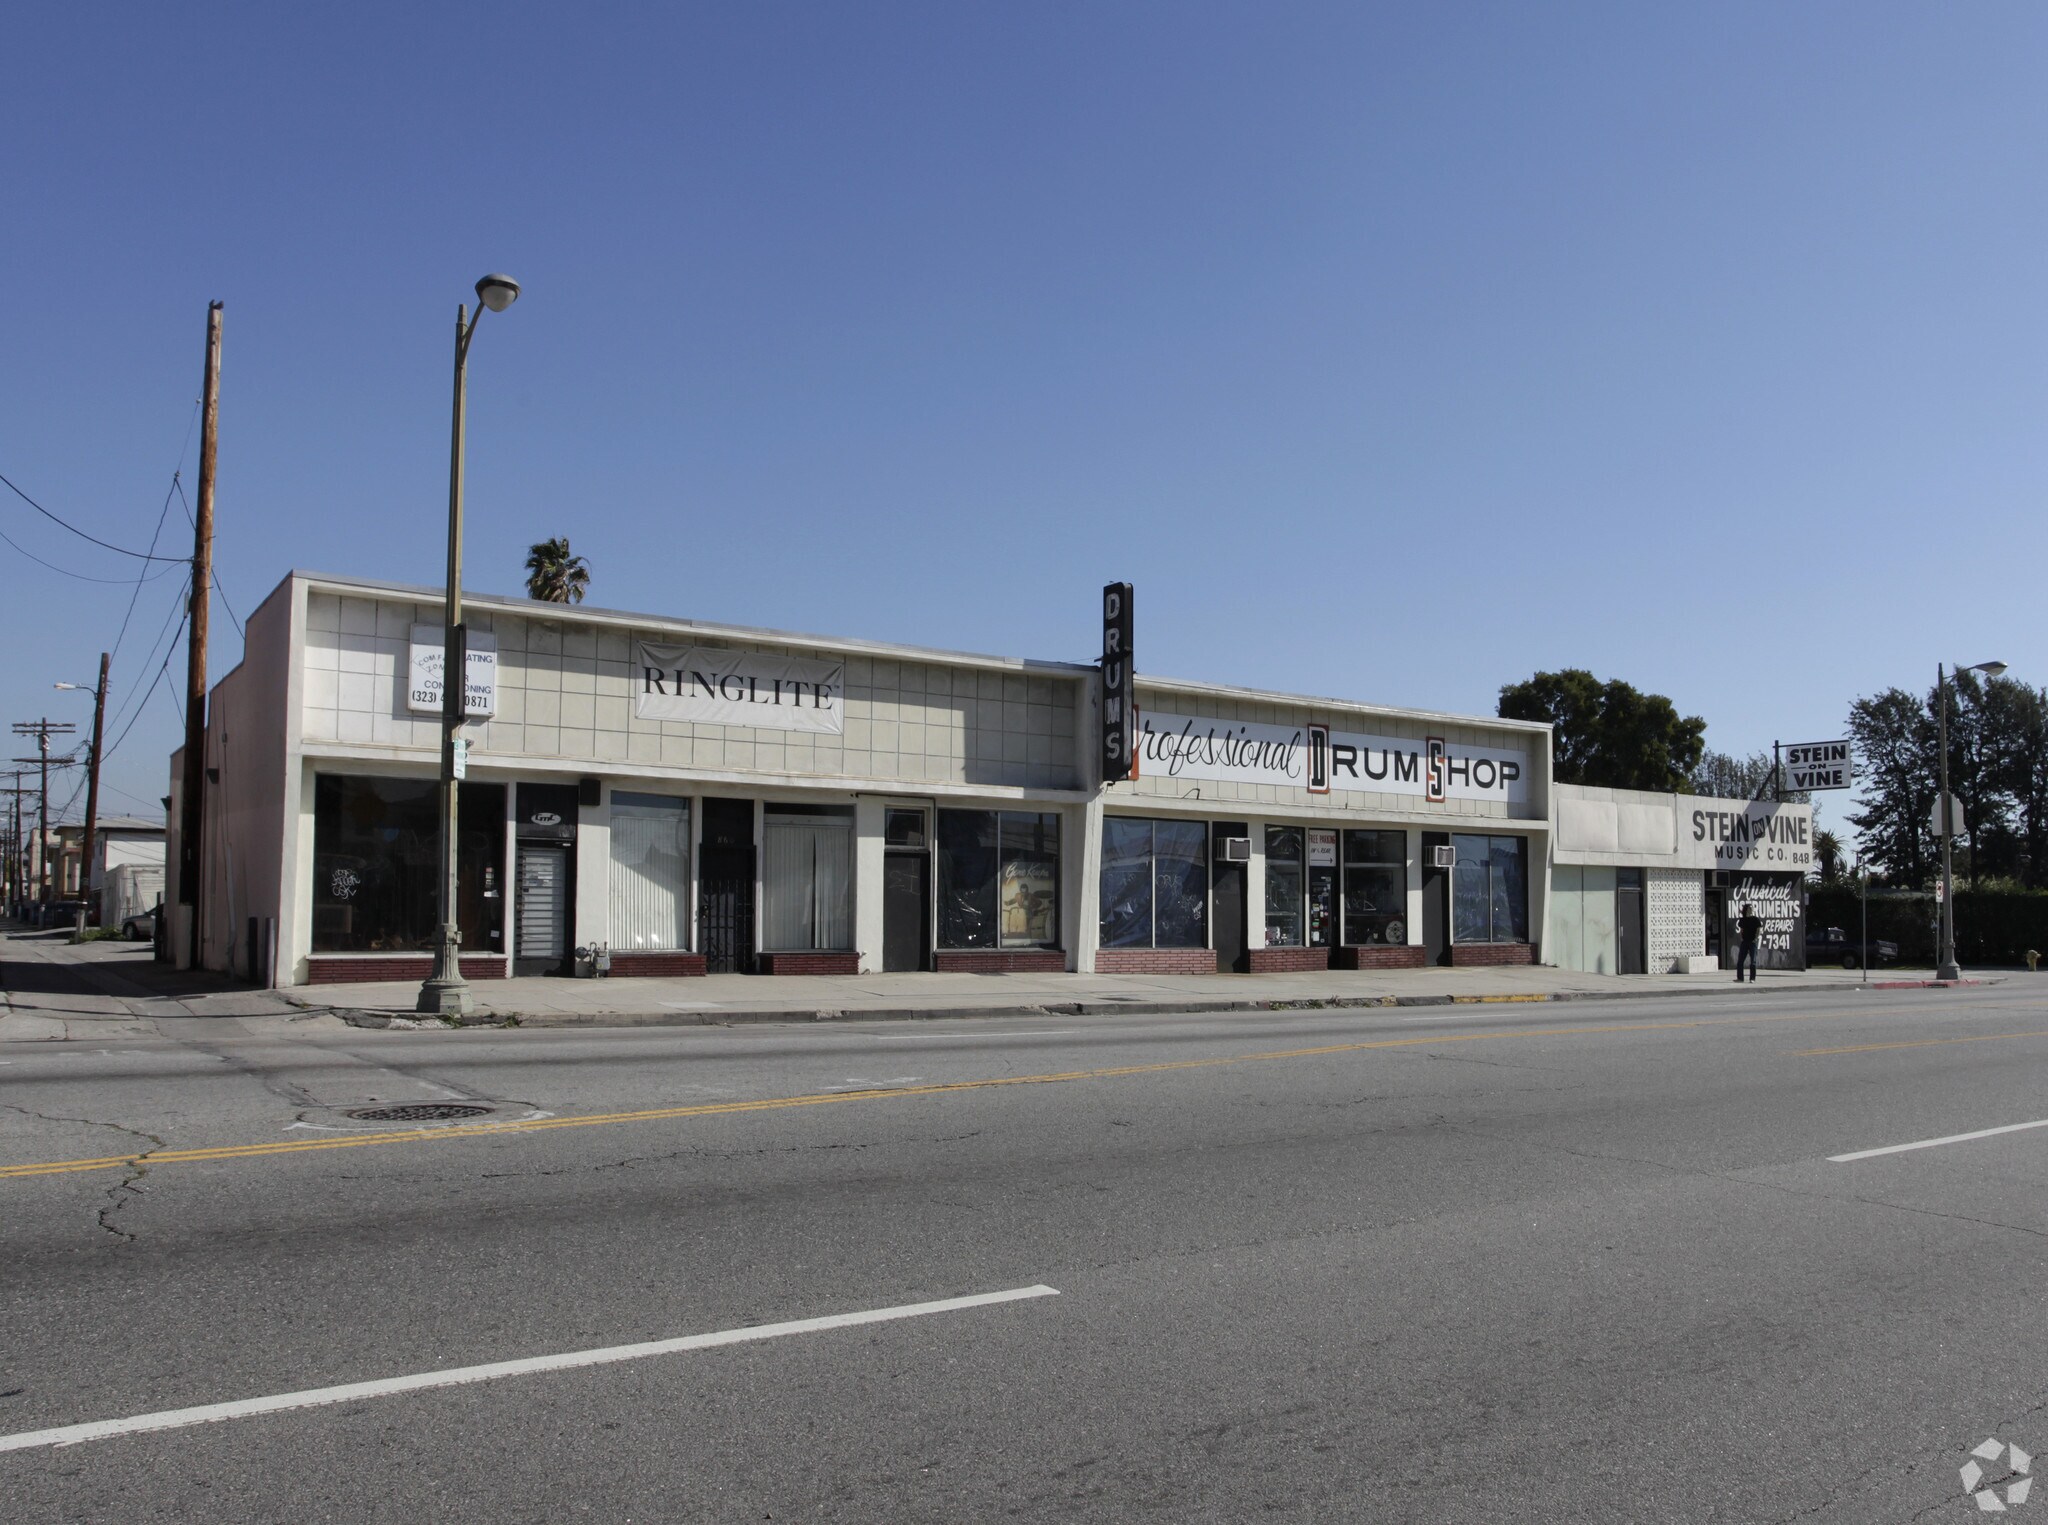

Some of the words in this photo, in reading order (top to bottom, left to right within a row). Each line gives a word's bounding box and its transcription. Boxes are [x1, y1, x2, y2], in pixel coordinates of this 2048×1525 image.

[418, 654, 445, 666] COMF
[466, 654, 493, 664] ATING
[426, 664, 444, 673] ZON
[1105, 593, 1120, 760] DRUMS
[412, 690, 437, 703] (323)
[642, 666, 834, 710] RINGLITE
[1132, 718, 1301, 779] rofessional
[1310, 727, 1418, 789] DRUM
[1428, 740, 1519, 798] SHOP
[1789, 744, 1846, 764] STEIN
[1793, 770, 1843, 788] VINE
[1692, 810, 1749, 842] STEIN
[1753, 818, 1764, 837] ON
[1765, 814, 1808, 845] VINE
[1308, 834, 1318, 844] FREE
[1319, 834, 1336, 844] PARKING
[1714, 845, 1759, 860] MUSIC
[1767, 848, 1788, 861] CO.
[1793, 852, 1810, 864] 848
[1733, 877, 1792, 900] Musical
[1728, 900, 1800, 918] INSRUMENTS
[1764, 919, 1794, 933] REPAIRS
